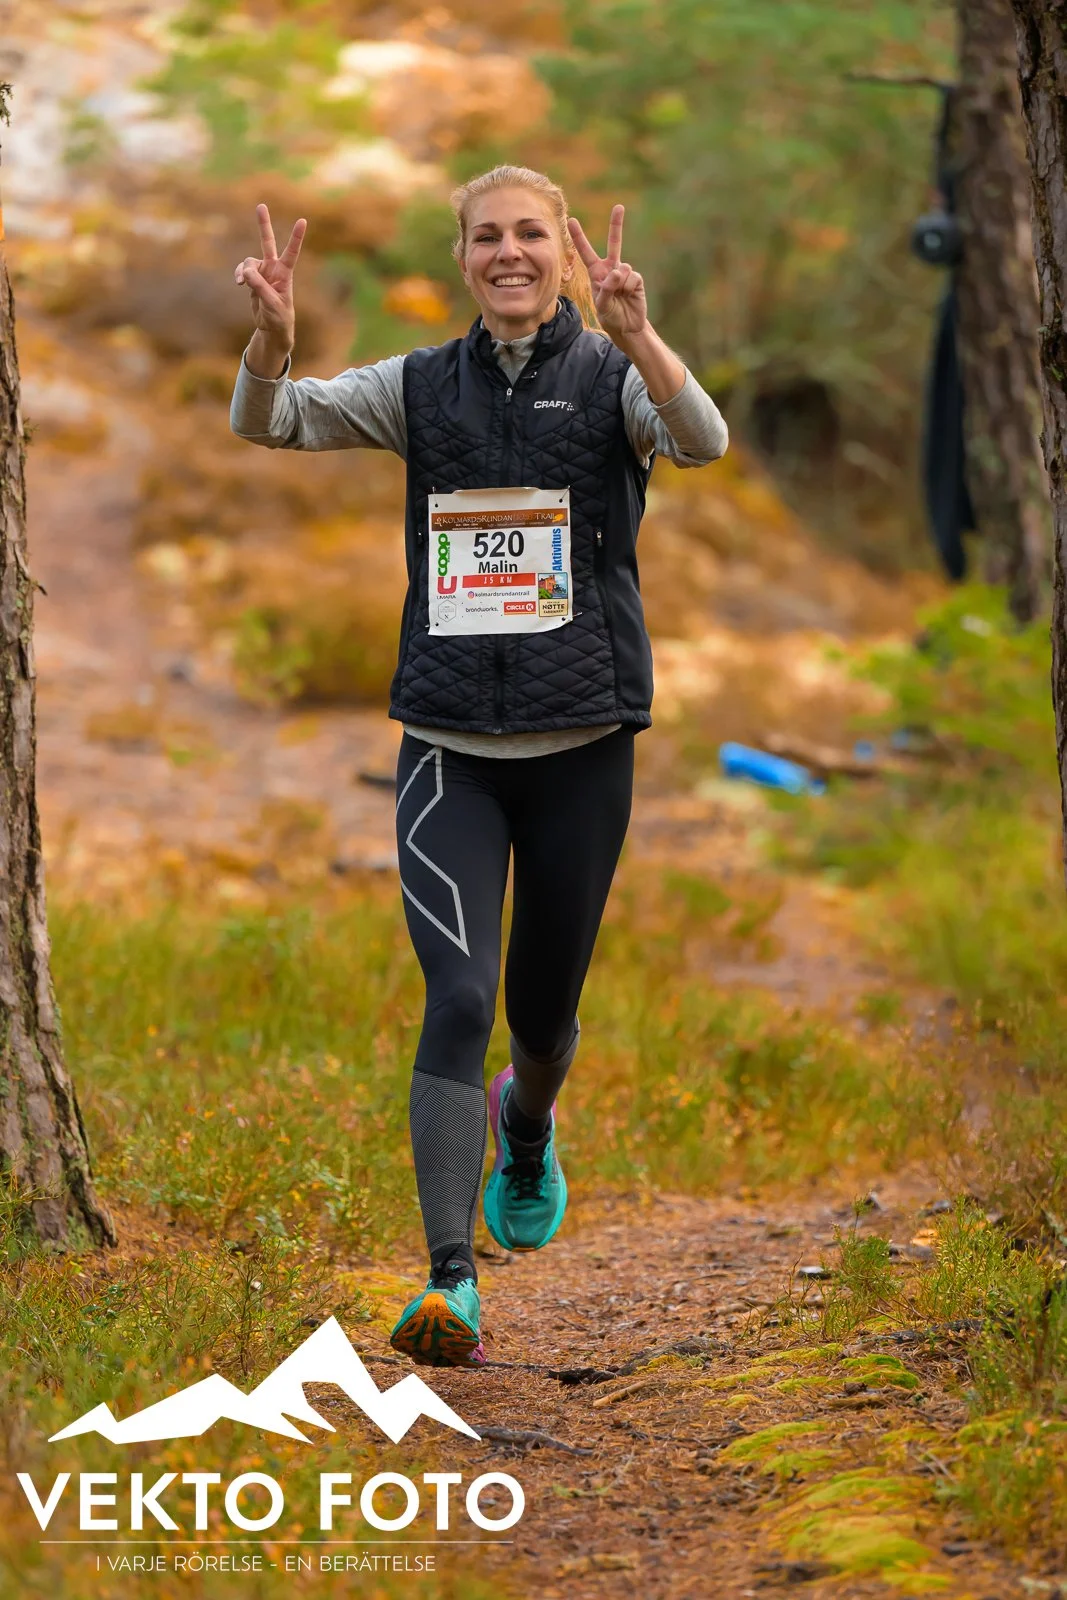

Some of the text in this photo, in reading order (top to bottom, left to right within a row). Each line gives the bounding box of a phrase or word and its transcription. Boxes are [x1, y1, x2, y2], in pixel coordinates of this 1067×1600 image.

[534, 400, 567, 409] CRAFT
[473, 530, 525, 558] 520
[552, 528, 562, 571] Aktivitus
[478, 561, 518, 574] Malin
[483, 576, 512, 584] 15 KM
